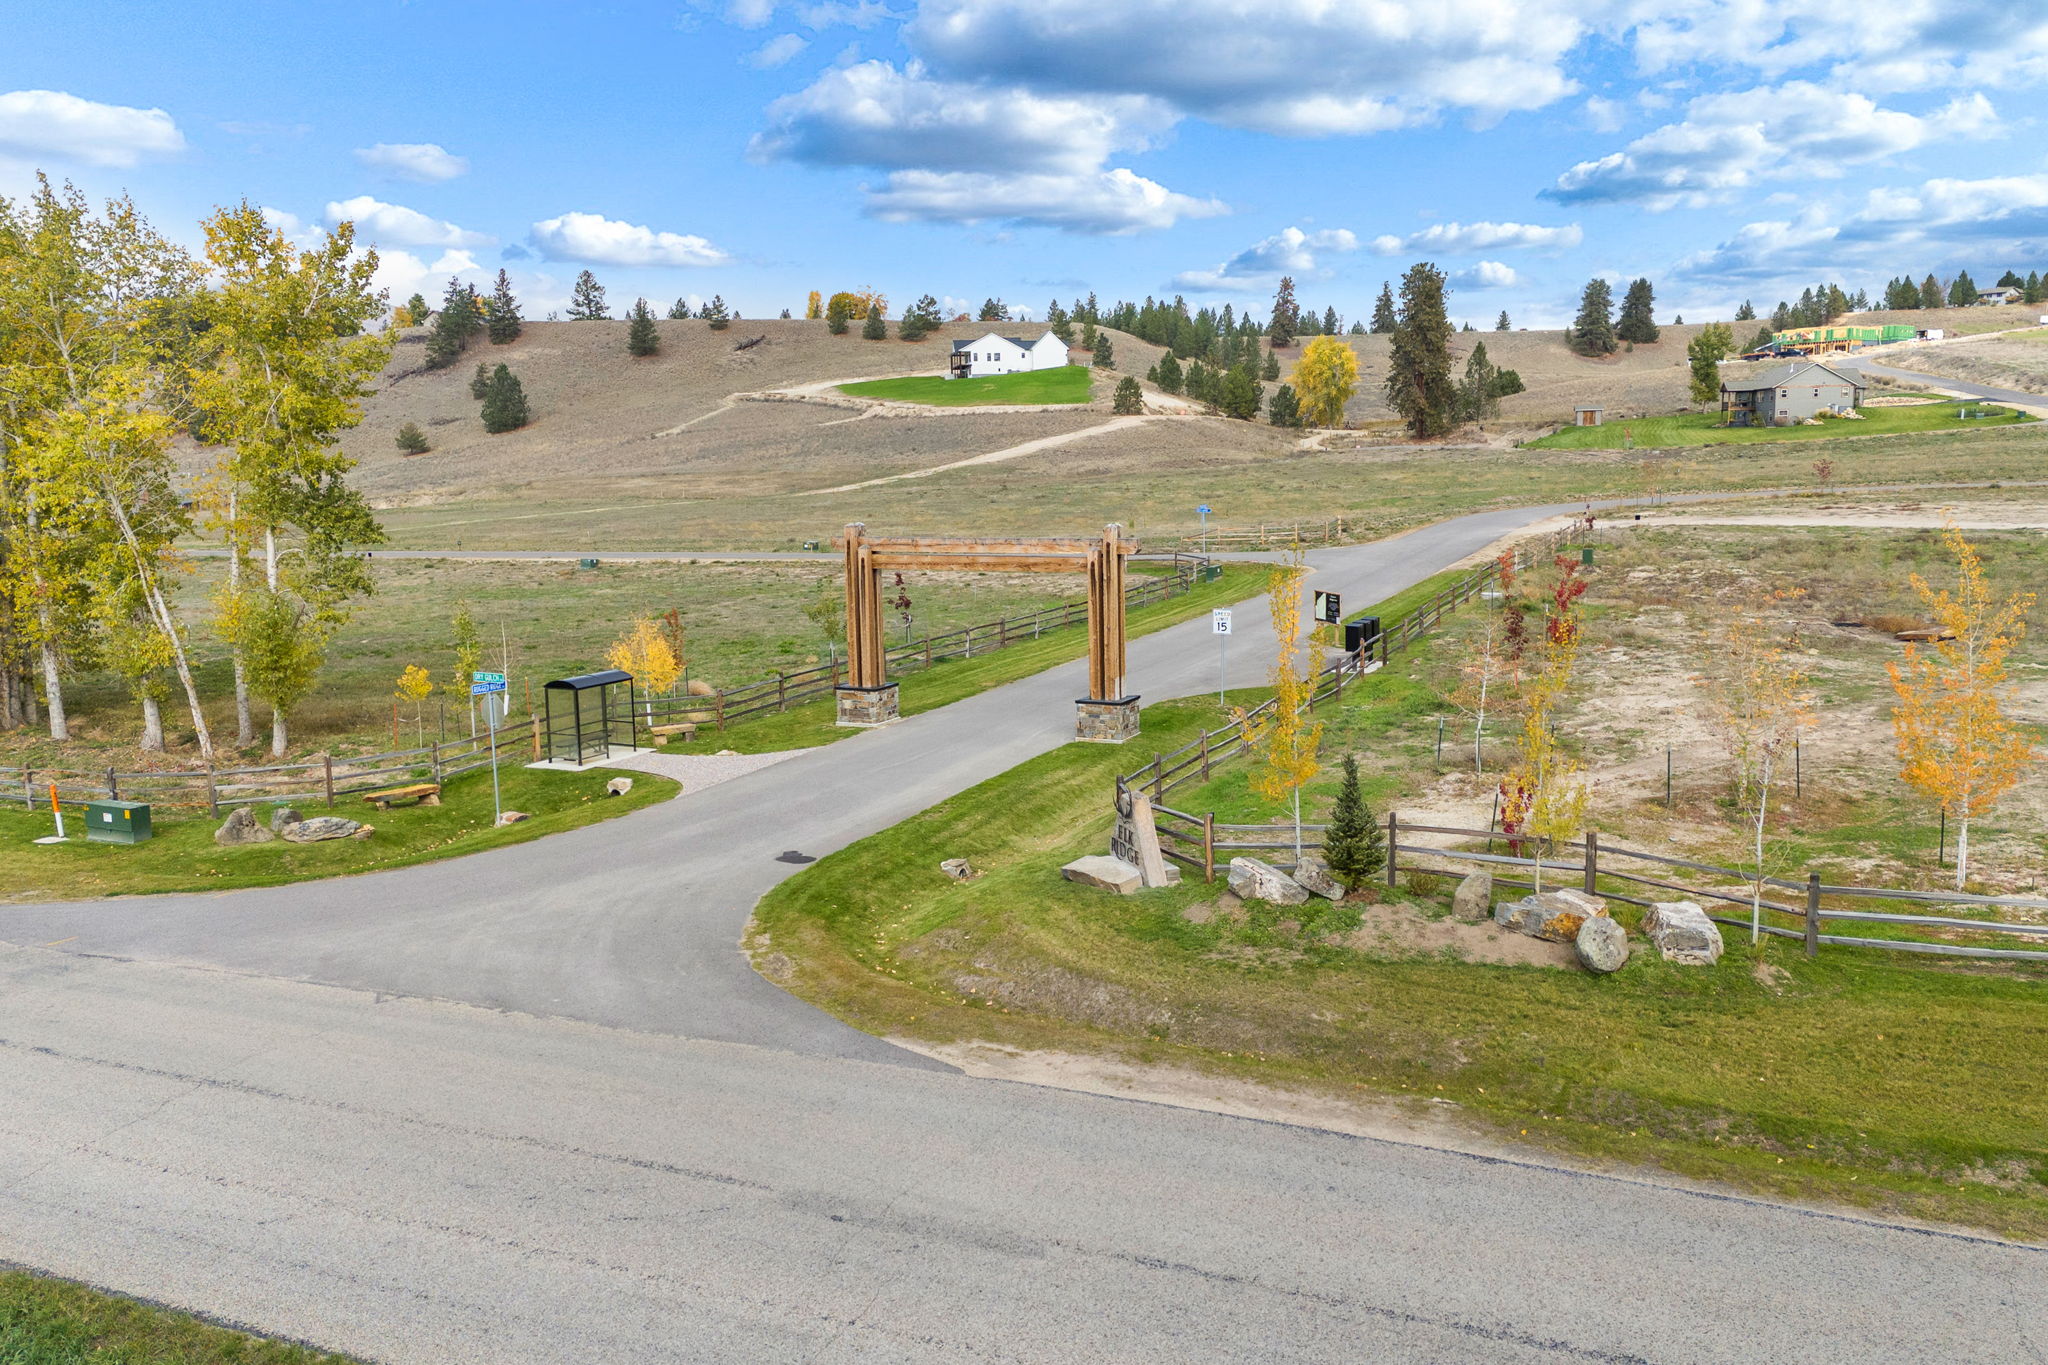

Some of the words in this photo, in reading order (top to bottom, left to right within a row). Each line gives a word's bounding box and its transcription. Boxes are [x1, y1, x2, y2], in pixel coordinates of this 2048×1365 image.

[1217, 622, 1227, 631] 15
[1118, 824, 1134, 846] ELK
[1111, 837, 1139, 866] RIDGE
